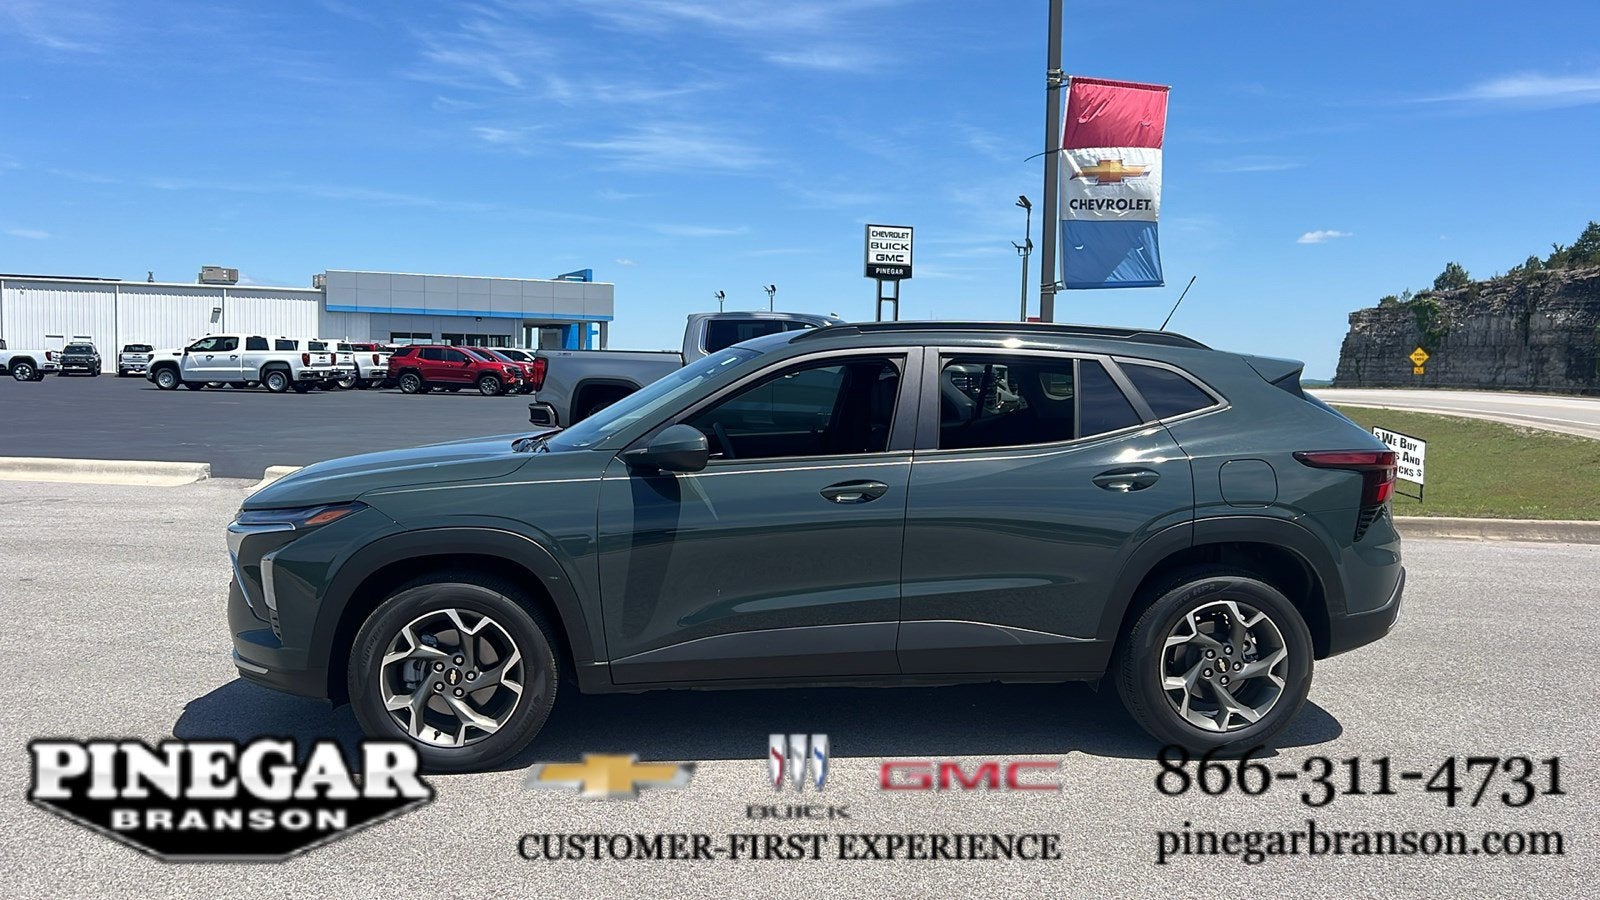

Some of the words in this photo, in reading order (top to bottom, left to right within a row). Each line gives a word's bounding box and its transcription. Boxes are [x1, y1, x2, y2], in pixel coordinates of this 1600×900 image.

[1069, 198, 1151, 211] CHEVROLET
[871, 230, 909, 239] CHEVROLET
[870, 242, 909, 251] BUICK
[875, 254, 904, 262] GMC
[875, 267, 904, 275] PINEGAR
[1400, 437, 1417, 452] BUY
[1402, 451, 1420, 466] AND
[1398, 465, 1414, 477] CKS
